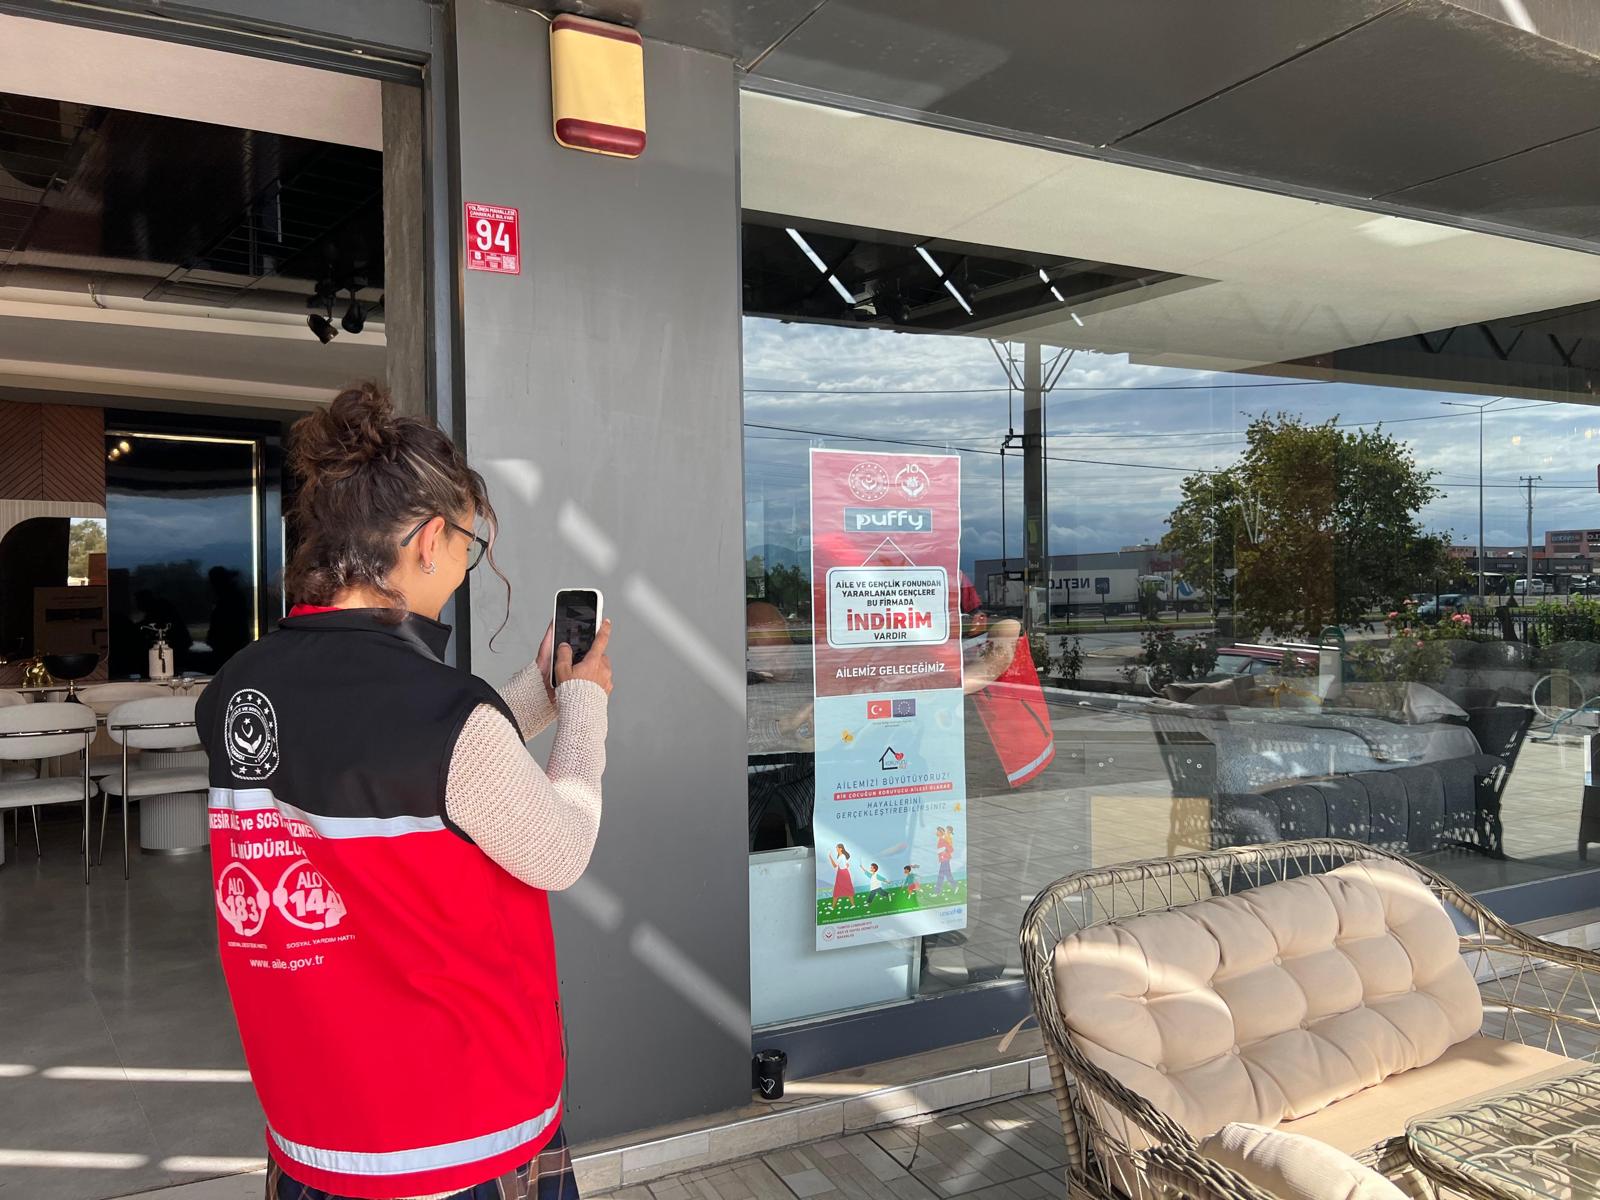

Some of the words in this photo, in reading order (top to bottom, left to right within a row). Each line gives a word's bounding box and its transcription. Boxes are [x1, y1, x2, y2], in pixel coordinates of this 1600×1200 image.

[476, 219, 510, 253] 94
[906, 463, 920, 474] 10
[856, 510, 924, 530] puffy
[835, 580, 854, 589] AİLE
[856, 580, 867, 588] VE
[868, 579, 900, 589] GENÇLİK
[901, 580, 942, 588] FONUNDAN
[842, 589, 897, 598] YARARLANAN
[898, 588, 936, 597] GENÇLERE
[866, 598, 878, 607] BU
[879, 597, 914, 606] FİRMADA
[846, 607, 933, 631] İNDİRİM
[874, 632, 907, 640] VARDIR
[835, 664, 877, 679] AİLEMİZ
[879, 661, 945, 675] GELECEĞİMİZ
[836, 778, 879, 790] AİLEMİZİ
[882, 773, 950, 786] BÜYÜTÜYORUZ!
[867, 797, 921, 809] HAYALLERİNİ
[241, 818, 254, 831] ve
[228, 877, 245, 896] ALO
[297, 871, 323, 889] ALO
[225, 895, 259, 922] 183
[286, 941, 311, 949] SOSYAL
[312, 936, 337, 945] YARDIM
